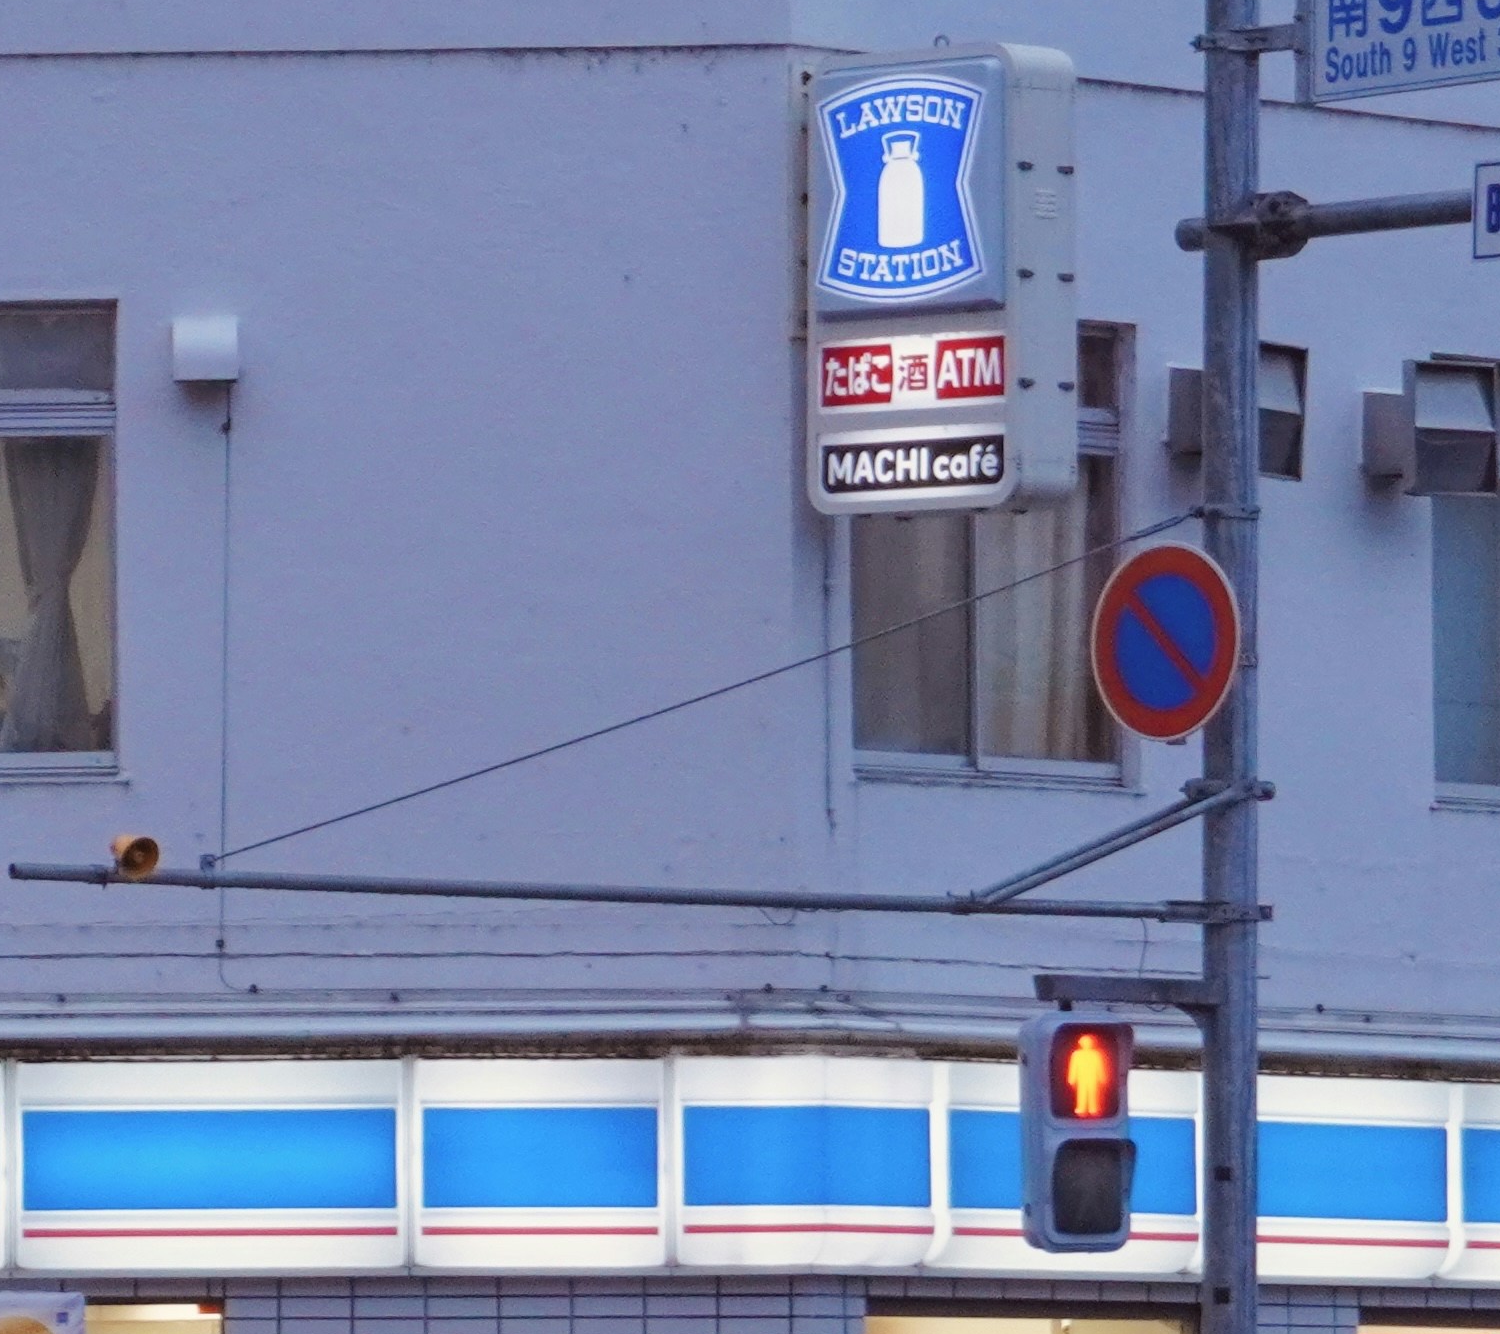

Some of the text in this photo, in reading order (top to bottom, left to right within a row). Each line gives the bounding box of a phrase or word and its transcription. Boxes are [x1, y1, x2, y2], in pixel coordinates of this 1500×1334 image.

[1324, 38, 1393, 84] South
[1402, 36, 1417, 71] 9
[1428, 33, 1486, 68] West
[835, 94, 965, 140] LAWSON
[837, 238, 964, 283] STATION
[824, 346, 1004, 397] たばこ 酒 ATM
[827, 443, 999, 487] MACHI café
